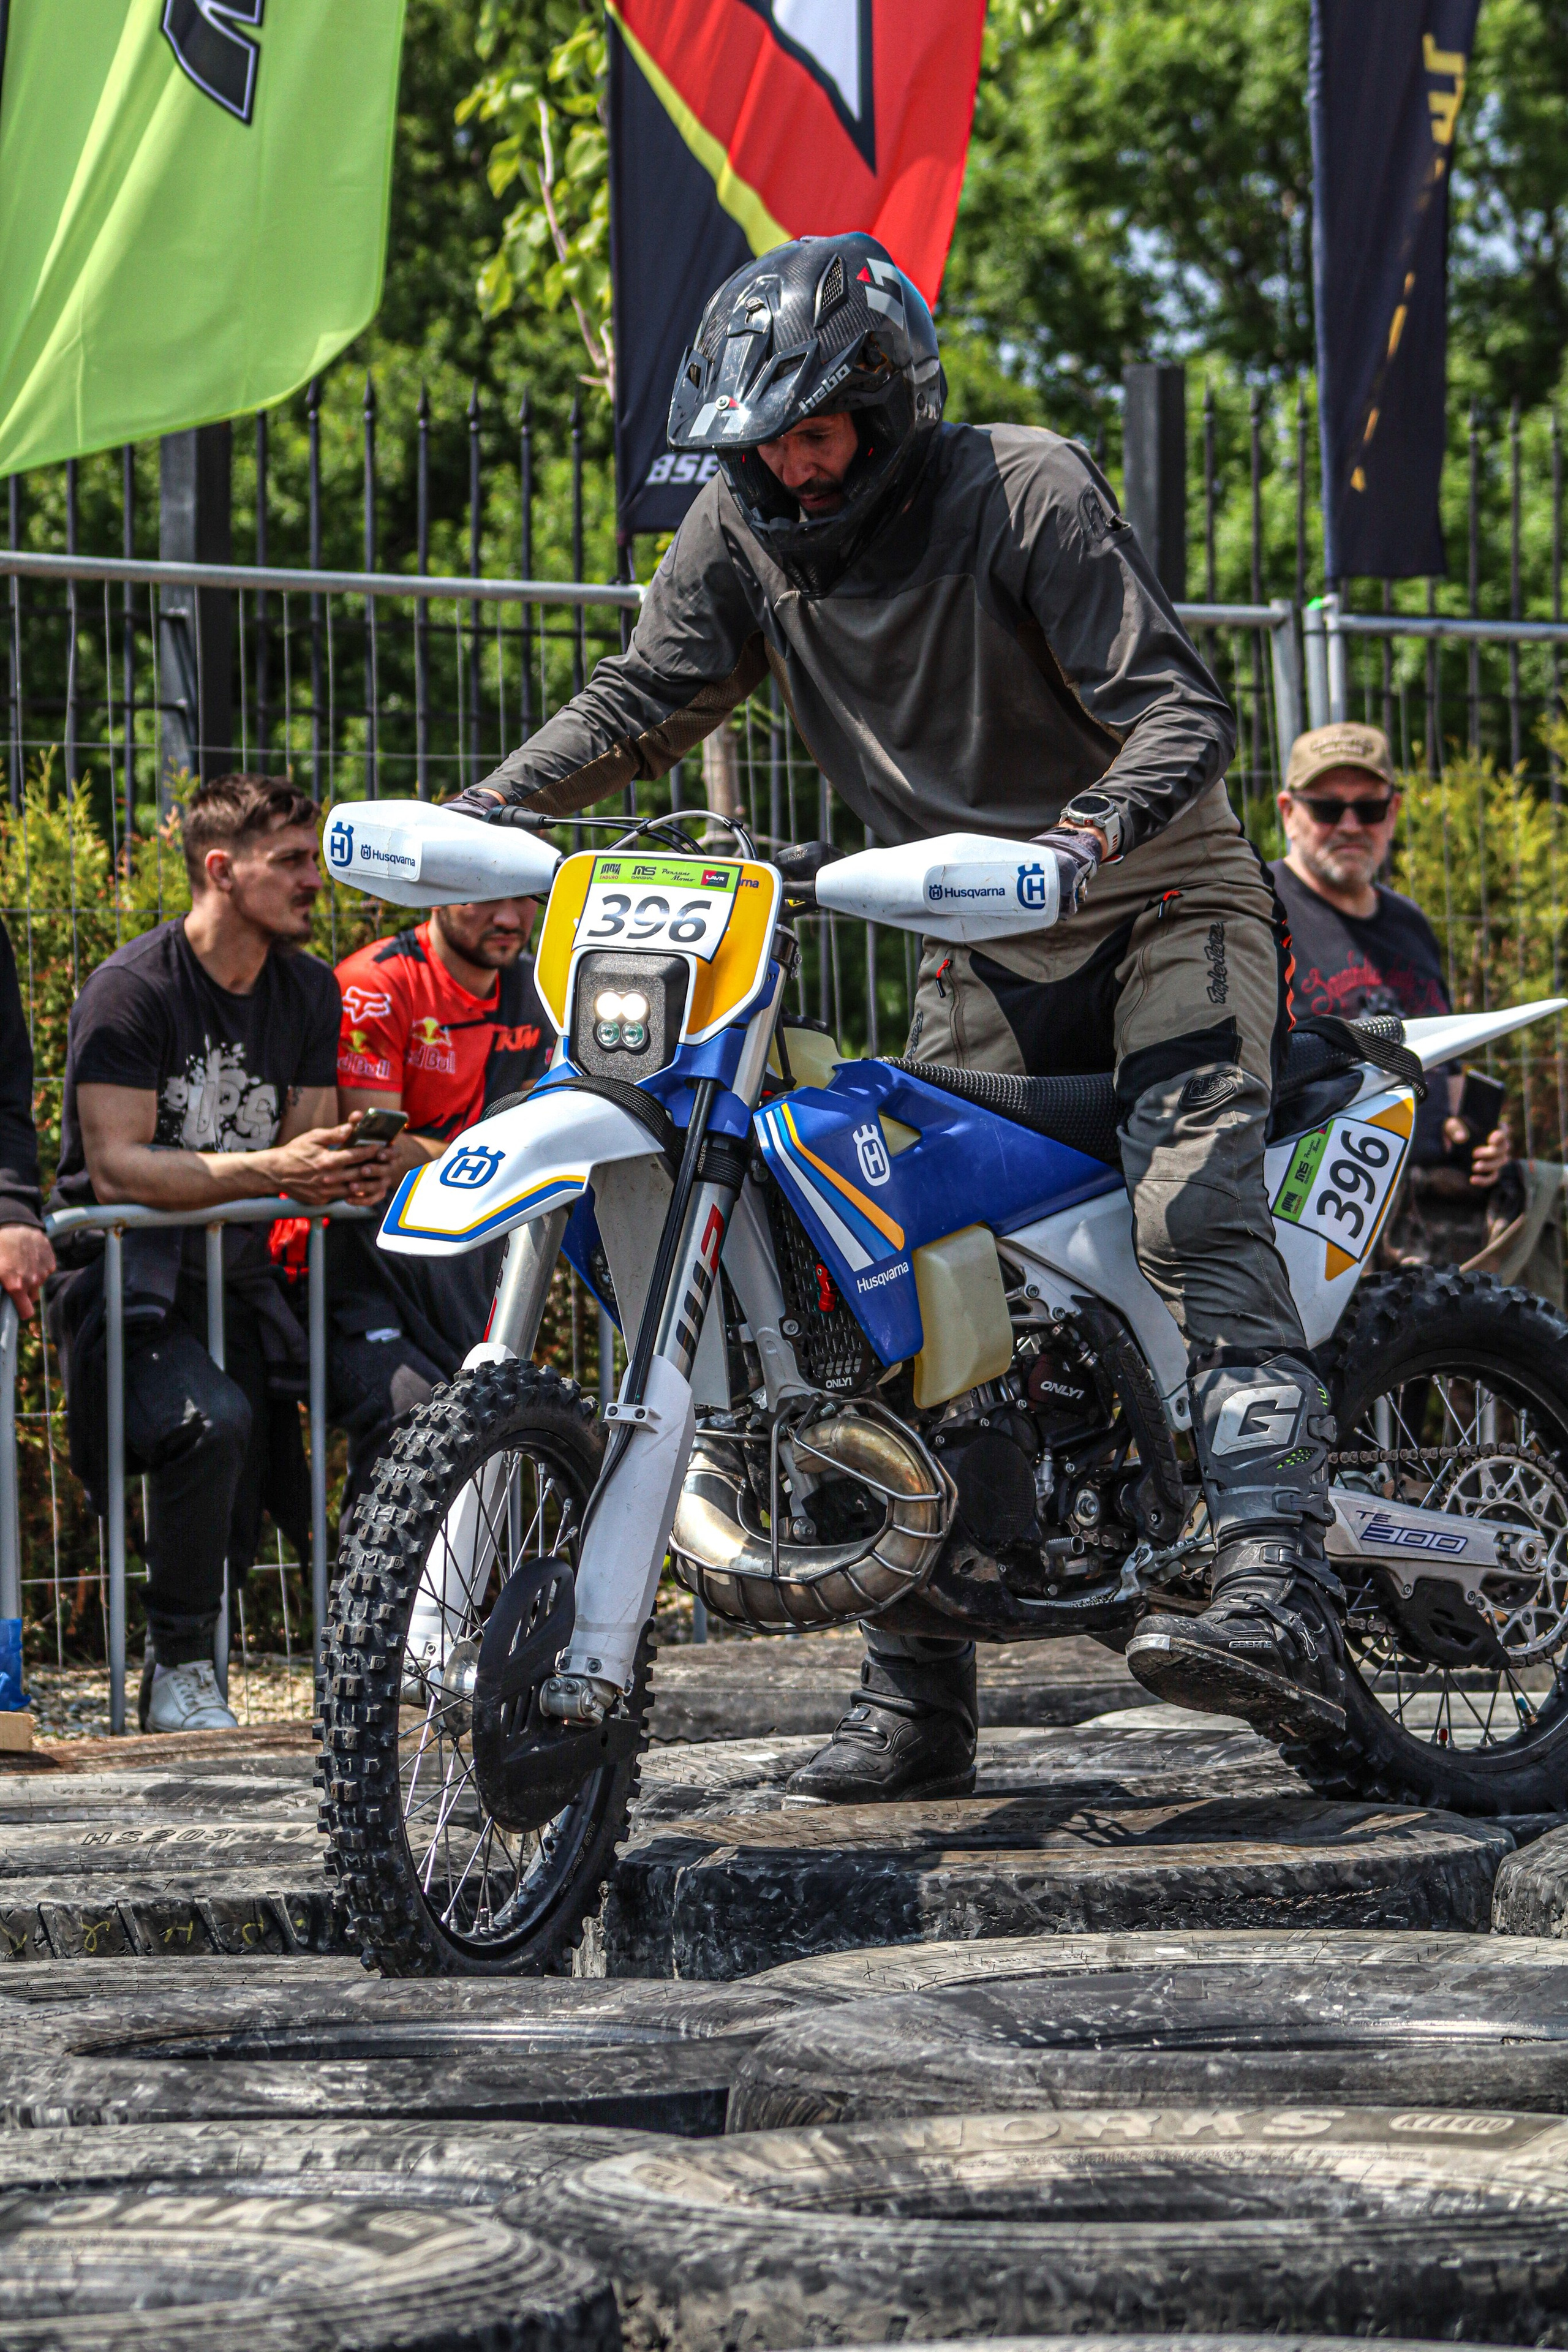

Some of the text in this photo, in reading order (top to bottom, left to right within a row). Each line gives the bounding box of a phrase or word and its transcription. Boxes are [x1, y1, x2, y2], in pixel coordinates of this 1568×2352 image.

[798, 364, 851, 415] hebo
[372, 850, 415, 867] Husqvarna
[944, 888, 1005, 899] Husqvarna
[587, 894, 712, 943] 396
[494, 1024, 540, 1052] KTM
[425, 1047, 455, 1074] Bull
[1316, 1129, 1390, 1239] 396
[856, 1261, 909, 1293] Husqvarna
[826, 1377, 852, 1389] ONLY1
[1040, 1381, 1085, 1399] ONLY1
[1211, 1385, 1302, 1456] G
[1355, 1510, 1392, 1523] TE
[1359, 1523, 1468, 1554] 300
[81, 1828, 236, 1845] HS203
